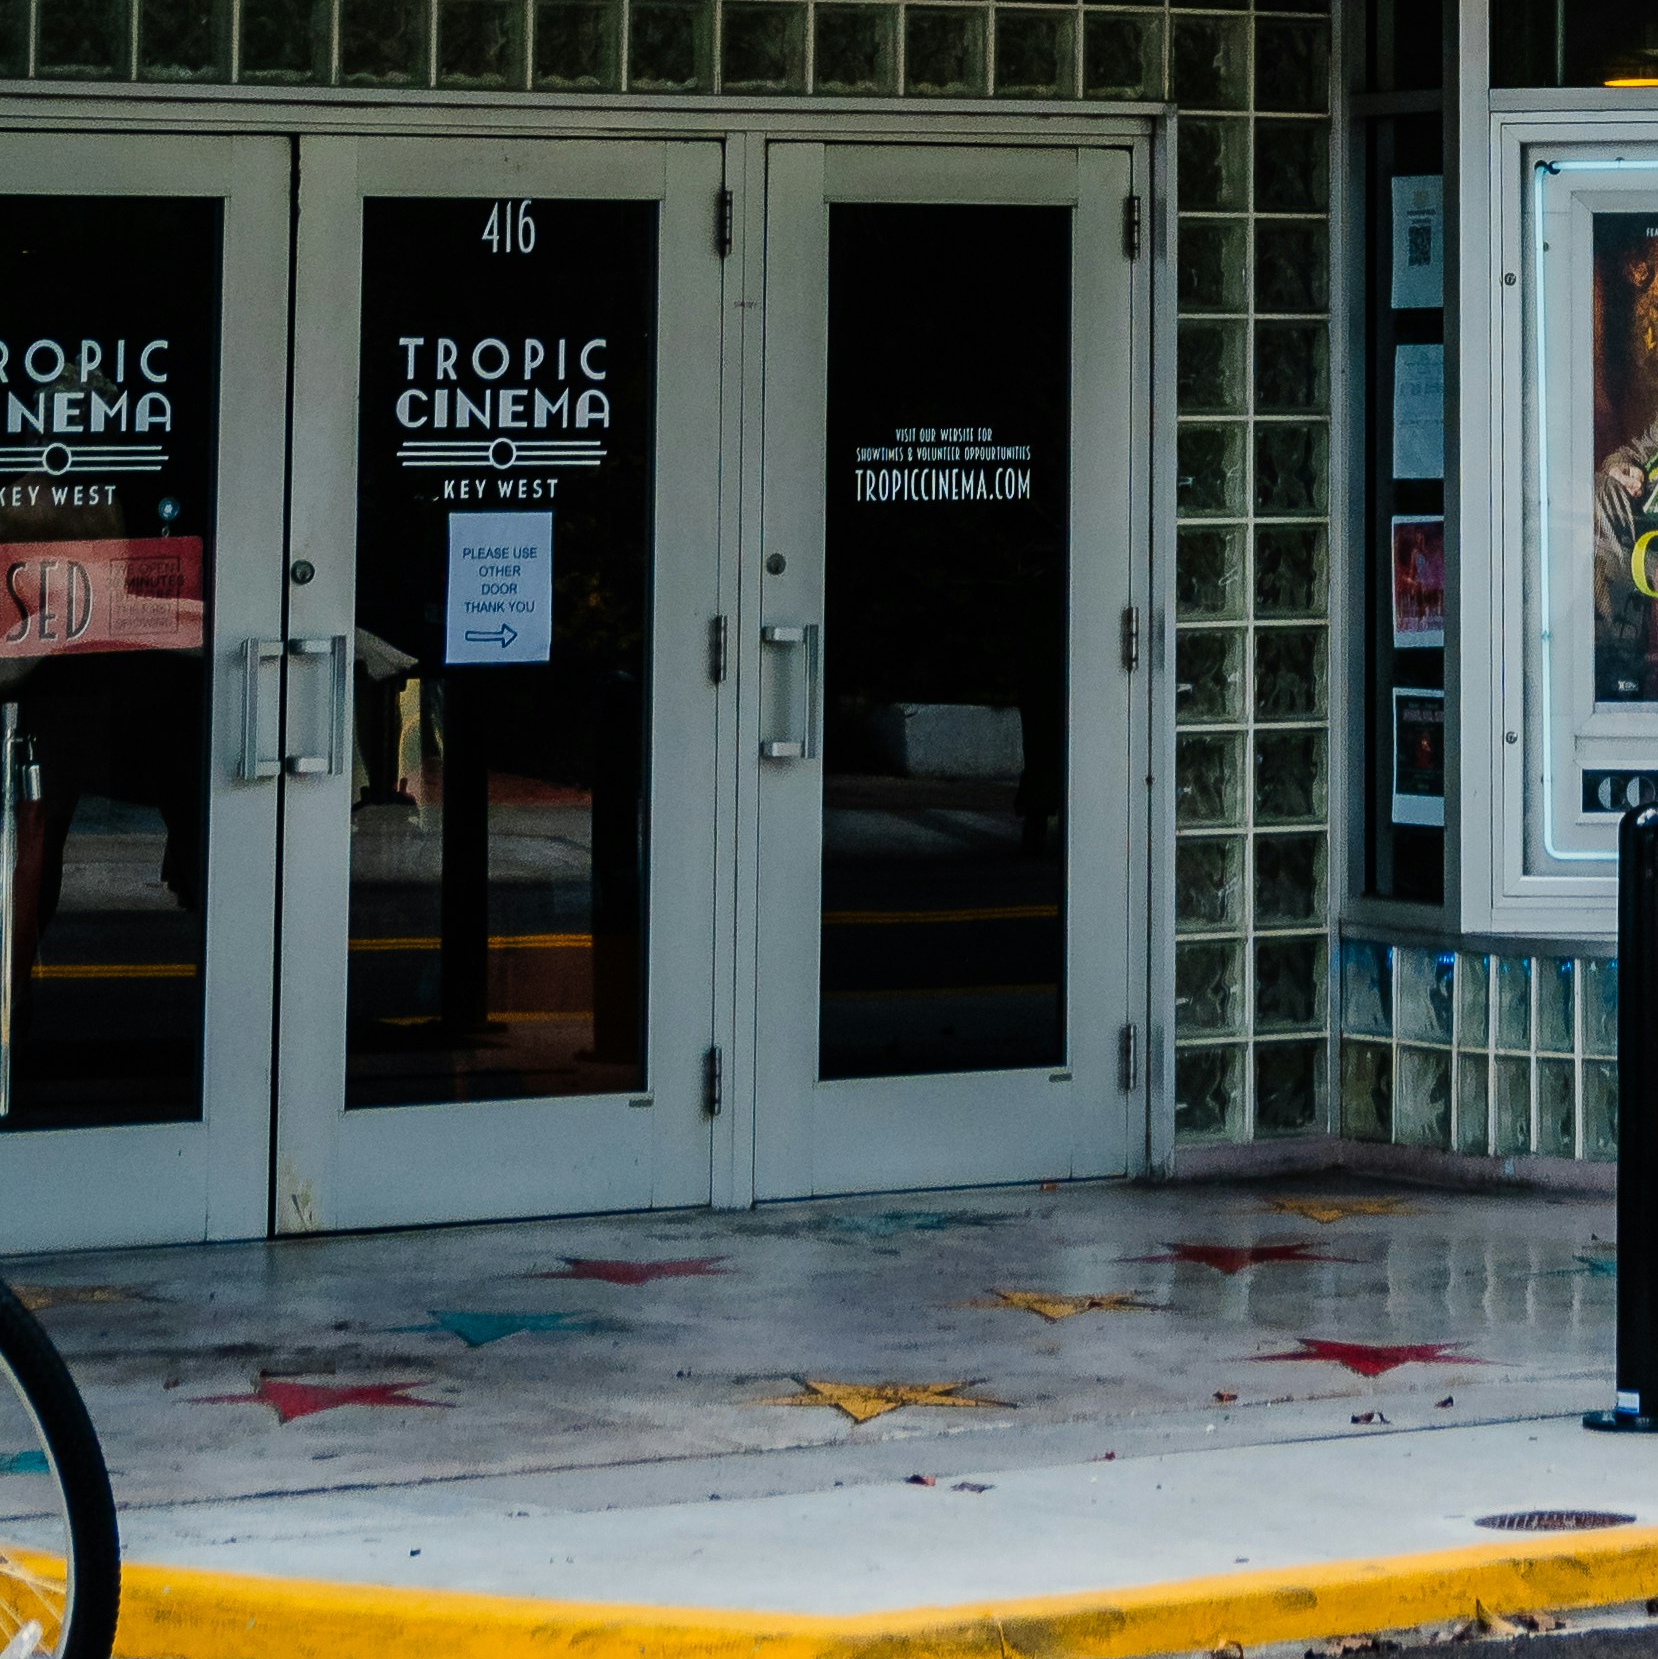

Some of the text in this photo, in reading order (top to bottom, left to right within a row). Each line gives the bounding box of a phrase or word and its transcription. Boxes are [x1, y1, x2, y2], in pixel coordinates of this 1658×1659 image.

[481, 200, 536, 254] 416
[399, 338, 607, 381] TROPIC
[396, 387, 610, 429] CINEMA
[896, 427, 993, 442] VISIT OUR WEBSITE FOR
[856, 446, 1031, 462] SHOWTIMES & VOLUNTEER OPPOURTUNITIES
[444, 479, 559, 499] KEY WEST
[855, 468, 1031, 501] TROPICCINEMA.COM
[52, 485, 117, 506] WEST
[463, 547, 538, 560] PLEASE USE
[478, 565, 521, 577] OTHER
[481, 583, 518, 595] DOOR
[464, 600, 536, 613] THANK YOU
